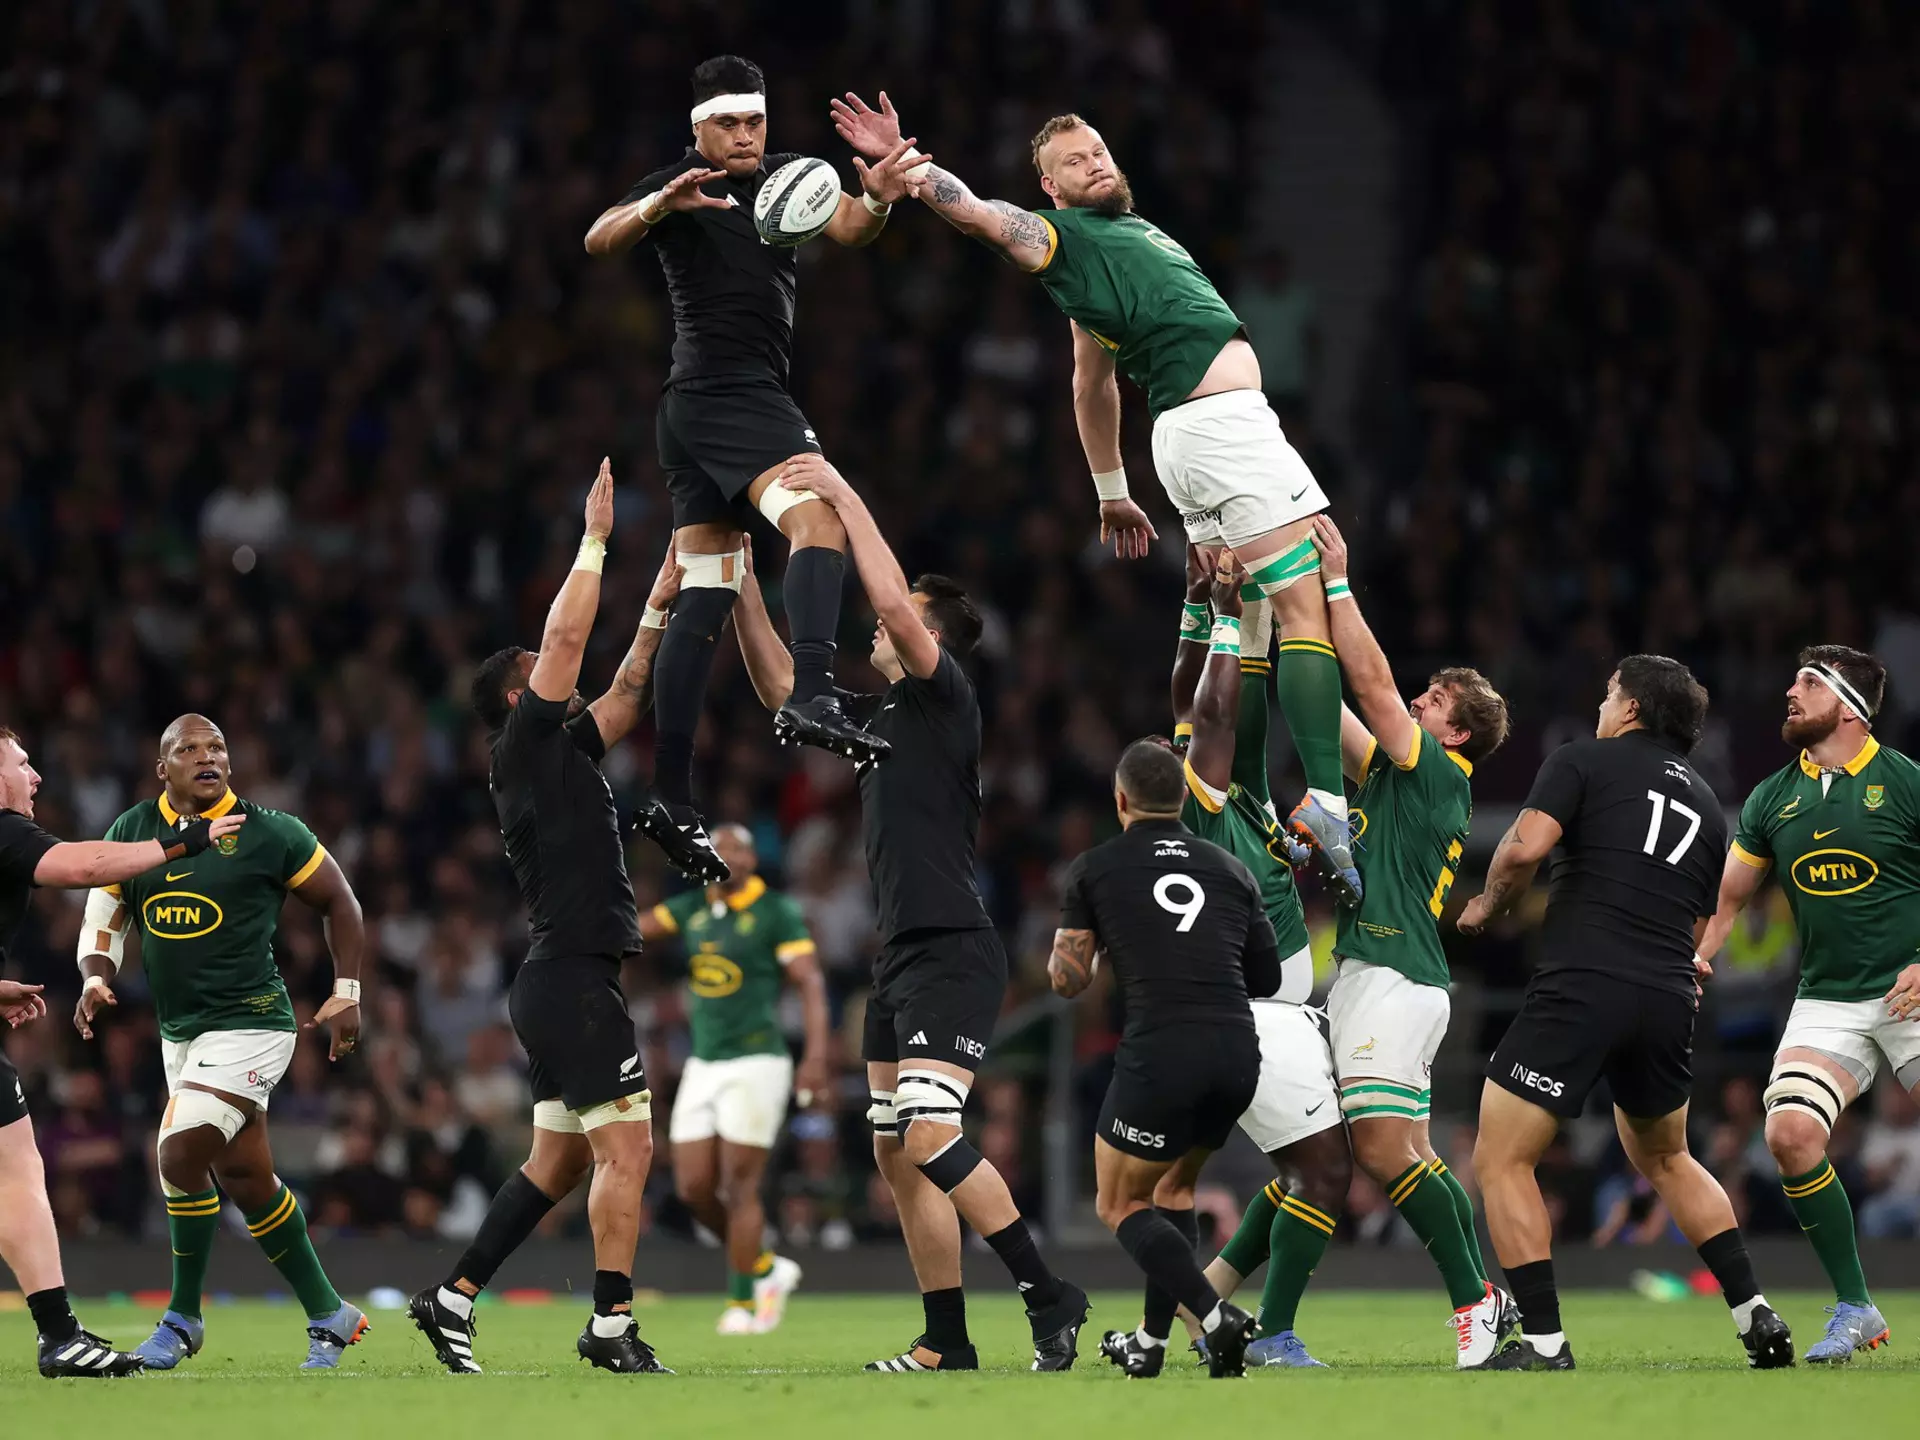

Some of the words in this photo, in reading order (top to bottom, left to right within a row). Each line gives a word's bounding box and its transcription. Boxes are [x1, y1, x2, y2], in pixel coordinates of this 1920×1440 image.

[805, 195, 816, 206] ALL
[814, 180, 830, 198] BLACKS
[1643, 788, 1702, 866] 17
[1155, 848, 1189, 857] ALTRAD
[1808, 863, 1858, 883] MTN
[155, 906, 201, 925] MTN
[1152, 873, 1205, 932] 9
[1510, 1062, 1565, 1097] INEOS
[1112, 1117, 1165, 1149] INEOS
